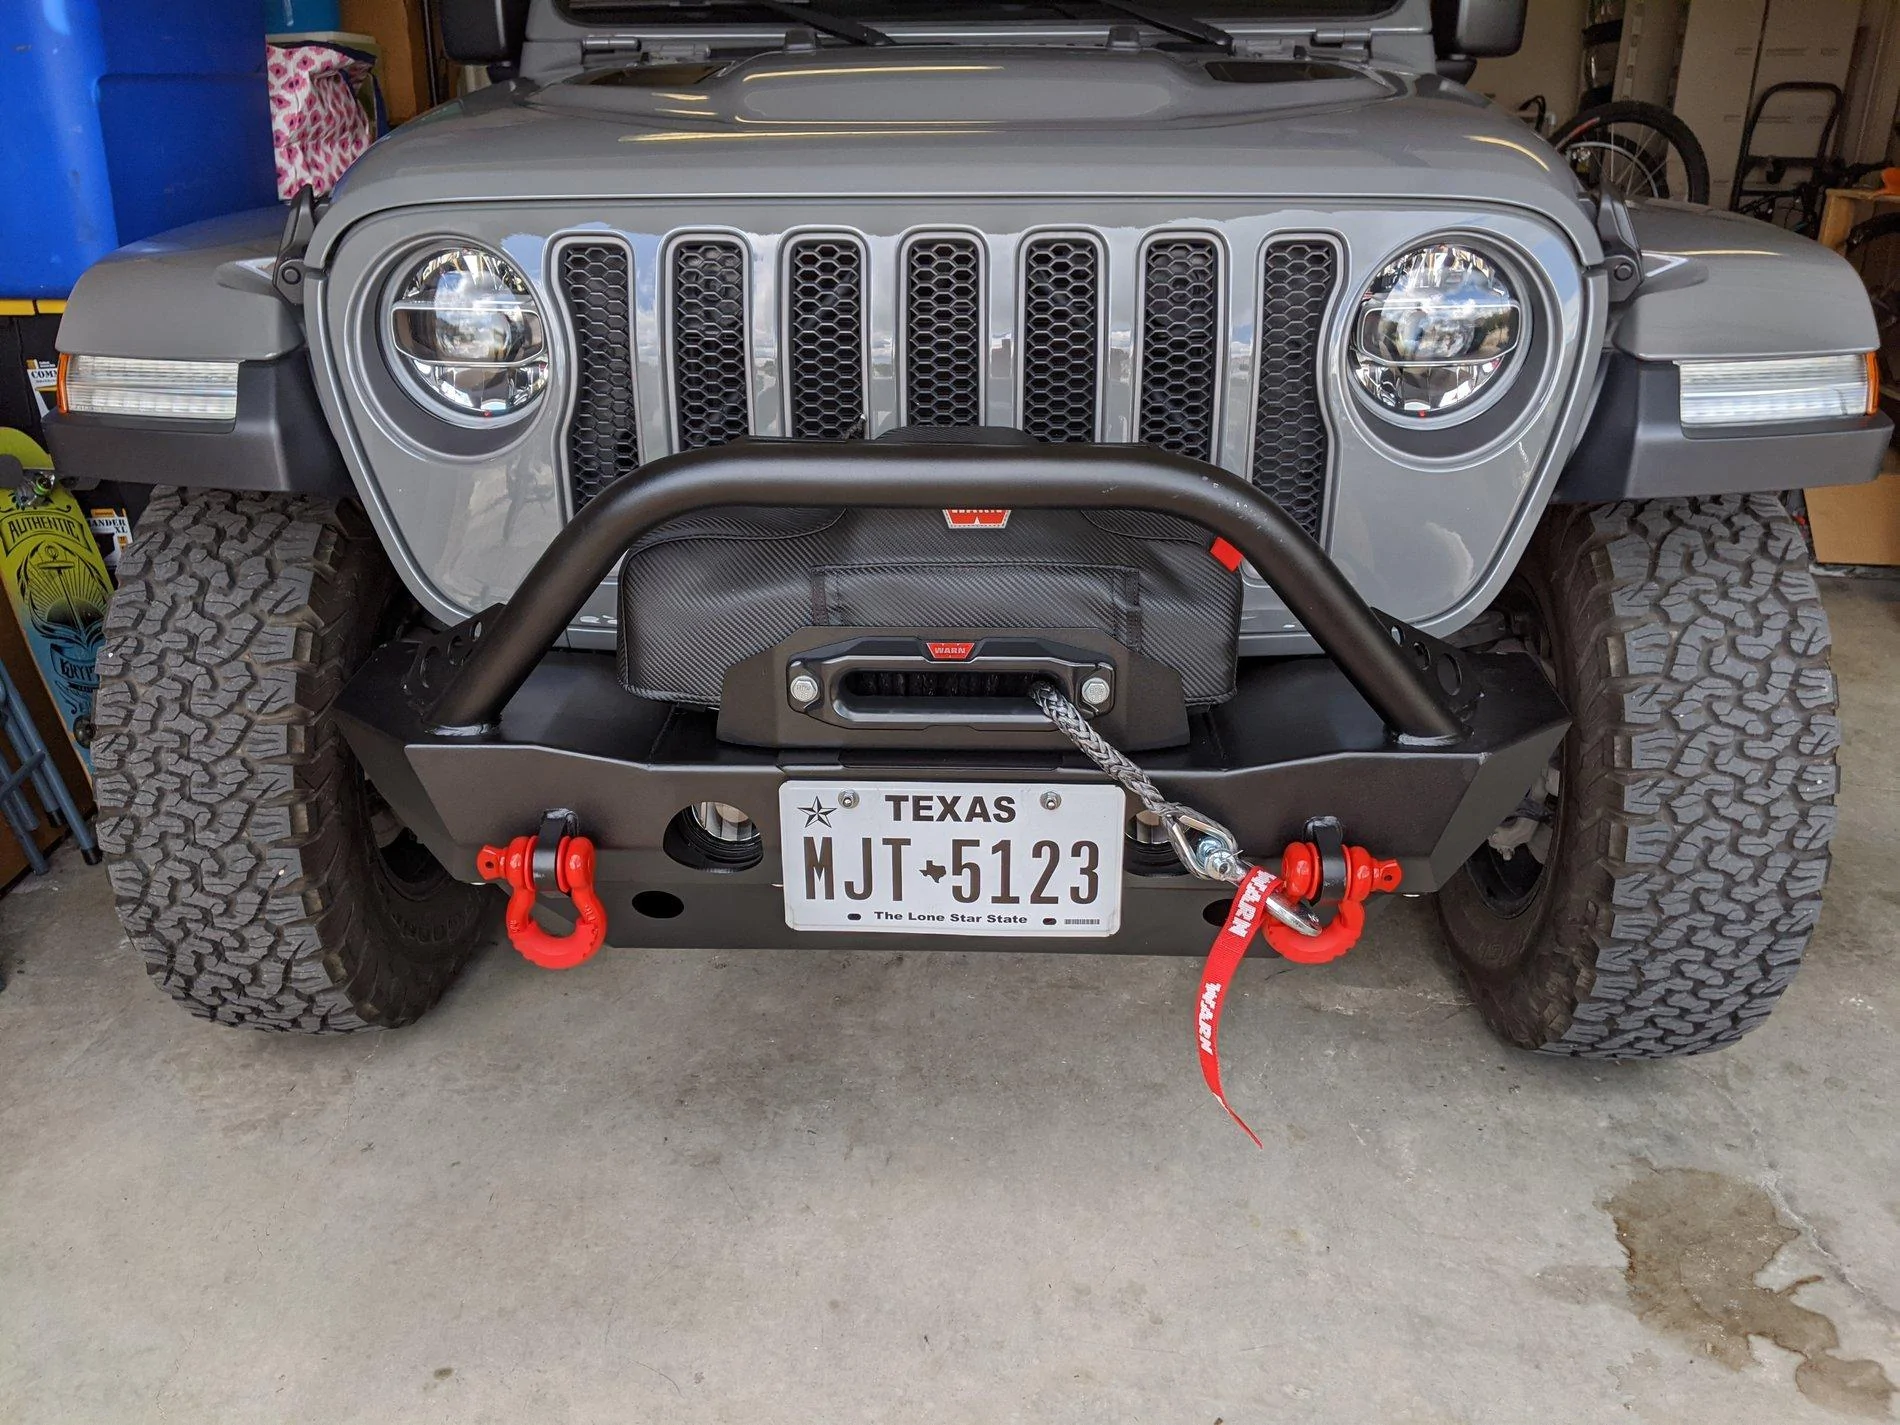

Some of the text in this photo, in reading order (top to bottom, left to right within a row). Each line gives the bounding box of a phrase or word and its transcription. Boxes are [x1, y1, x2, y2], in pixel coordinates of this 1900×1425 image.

[8, 516, 80, 543] AUTHENTIC
[884, 794, 1017, 823] TEXAS
[803, 836, 1100, 905] MJT 5123
[874, 911, 1028, 924] The Lone Star State
[1228, 869, 1278, 938] WARN
[1199, 982, 1222, 1056] WARN
